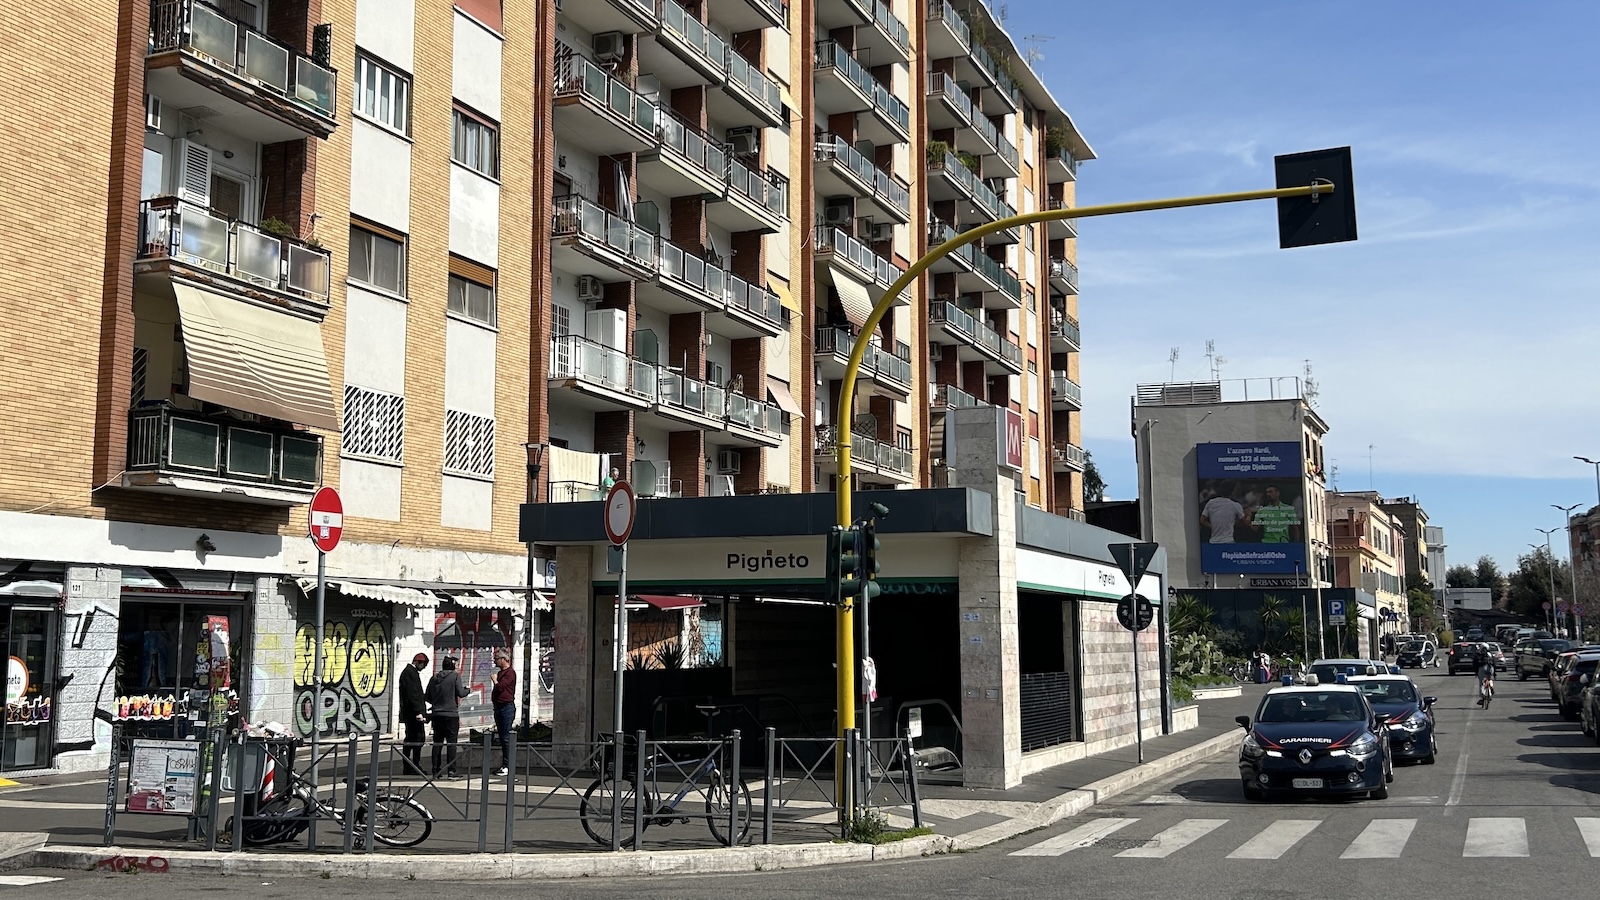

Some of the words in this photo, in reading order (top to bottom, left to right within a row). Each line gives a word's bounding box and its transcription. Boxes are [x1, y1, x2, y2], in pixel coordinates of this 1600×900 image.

[1008, 423, 1021, 458] M
[1259, 455, 1281, 463] mondo,
[1223, 464, 1251, 472] sconfigge
[727, 552, 809, 572] Pigneto
[72, 584, 81, 592] 121
[1331, 601, 1342, 614] P
